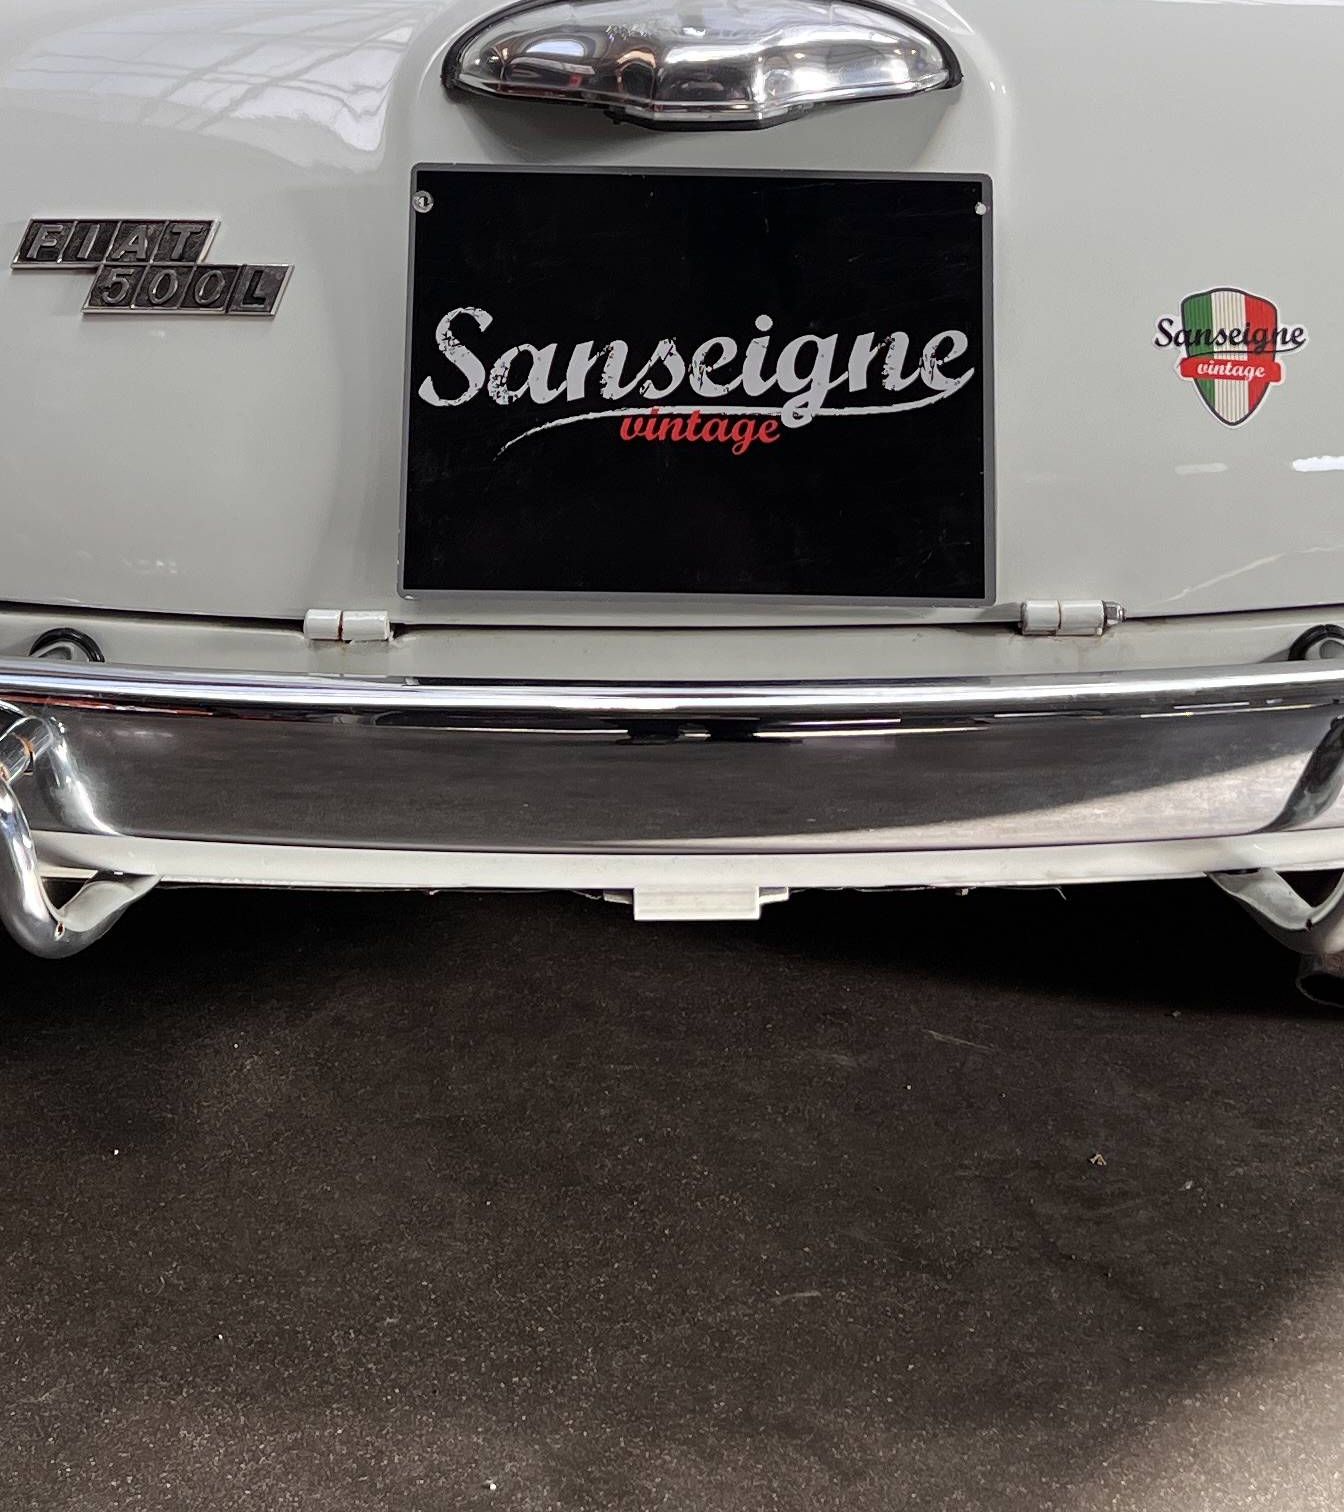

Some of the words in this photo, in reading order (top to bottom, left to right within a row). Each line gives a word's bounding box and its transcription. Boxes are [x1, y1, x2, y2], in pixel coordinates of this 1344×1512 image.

[25, 223, 204, 262] FIAT
[102, 268, 268, 310] 500L
[1154, 317, 1306, 355] Sanseigne
[417, 306, 976, 429] Sanseigne
[1196, 360, 1267, 382] vintage
[619, 406, 783, 456] vintage
